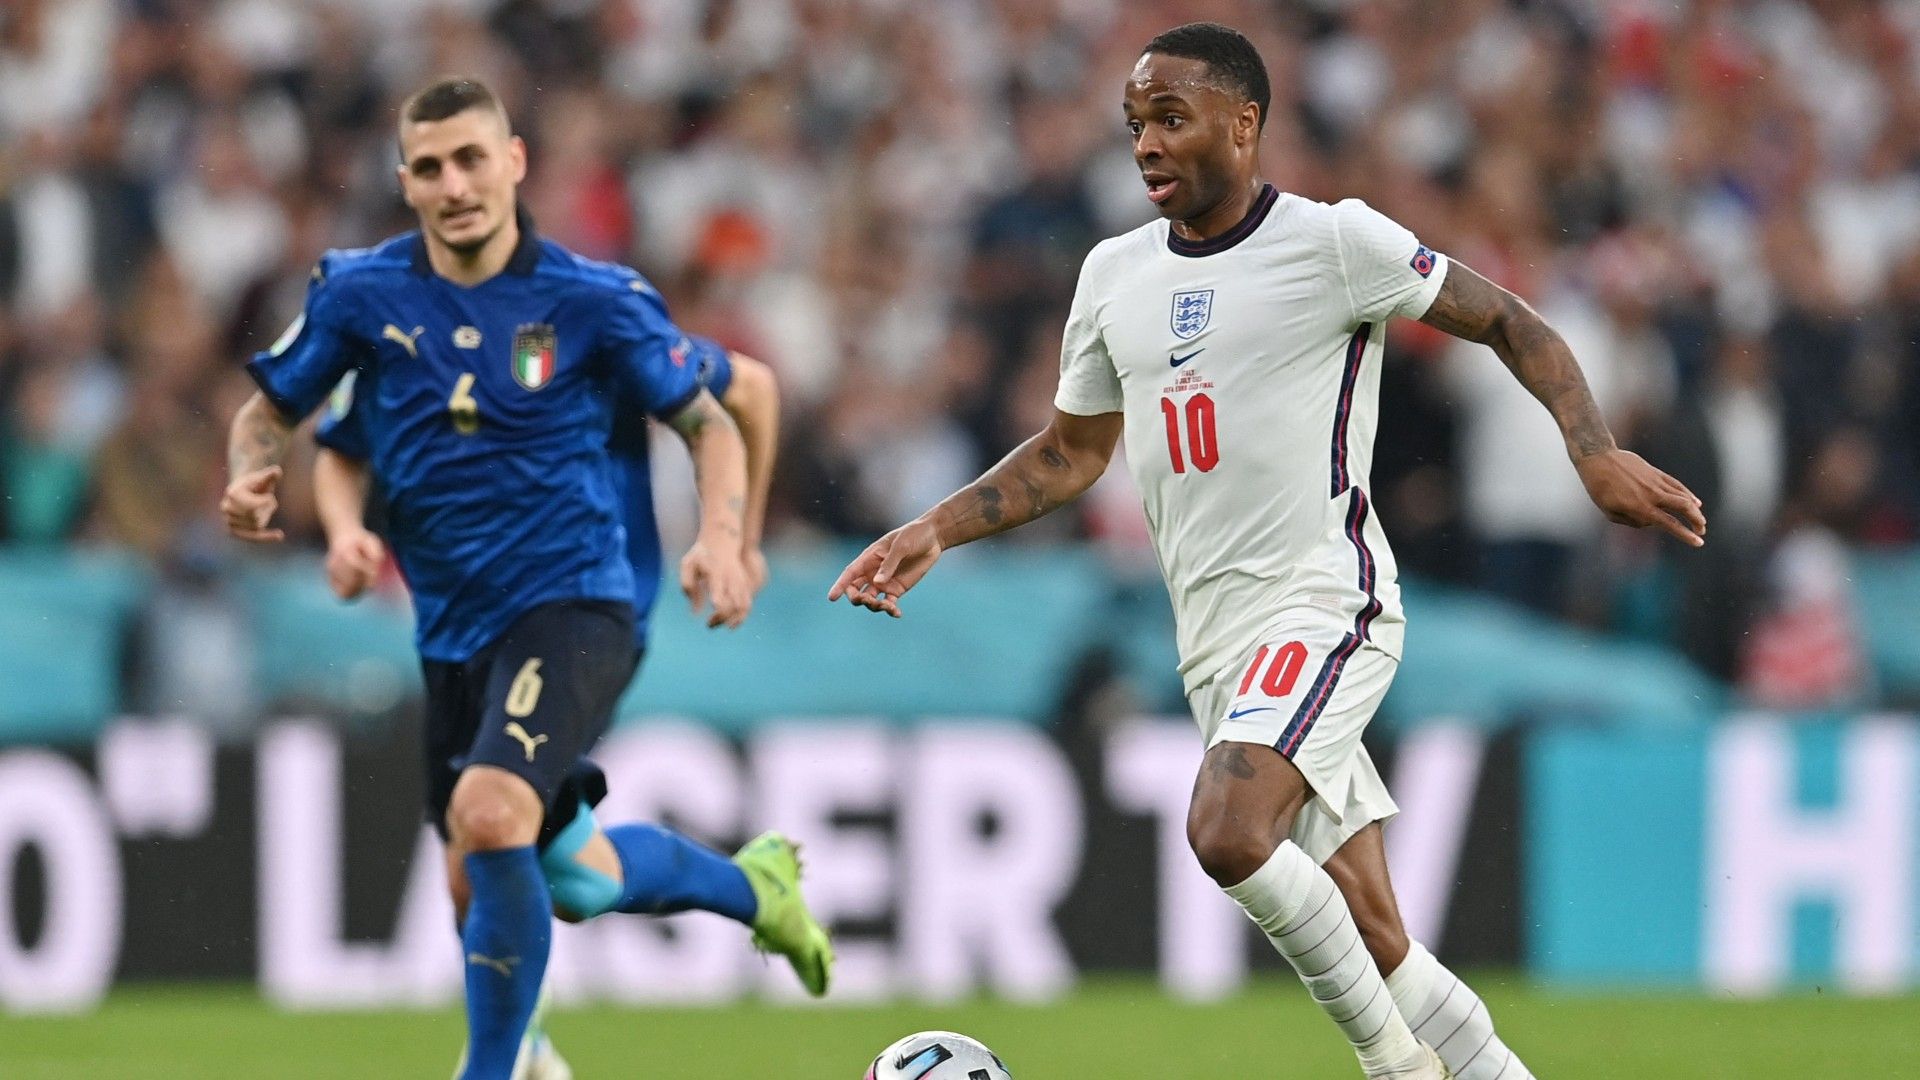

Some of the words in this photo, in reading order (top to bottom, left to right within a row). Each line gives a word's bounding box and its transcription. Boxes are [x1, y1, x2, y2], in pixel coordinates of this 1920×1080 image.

[447, 371, 478, 436] 6
[1161, 393, 1220, 474] 10
[504, 656, 544, 718] 6
[1236, 640, 1309, 698] 10
[1703, 713, 1916, 998] H
